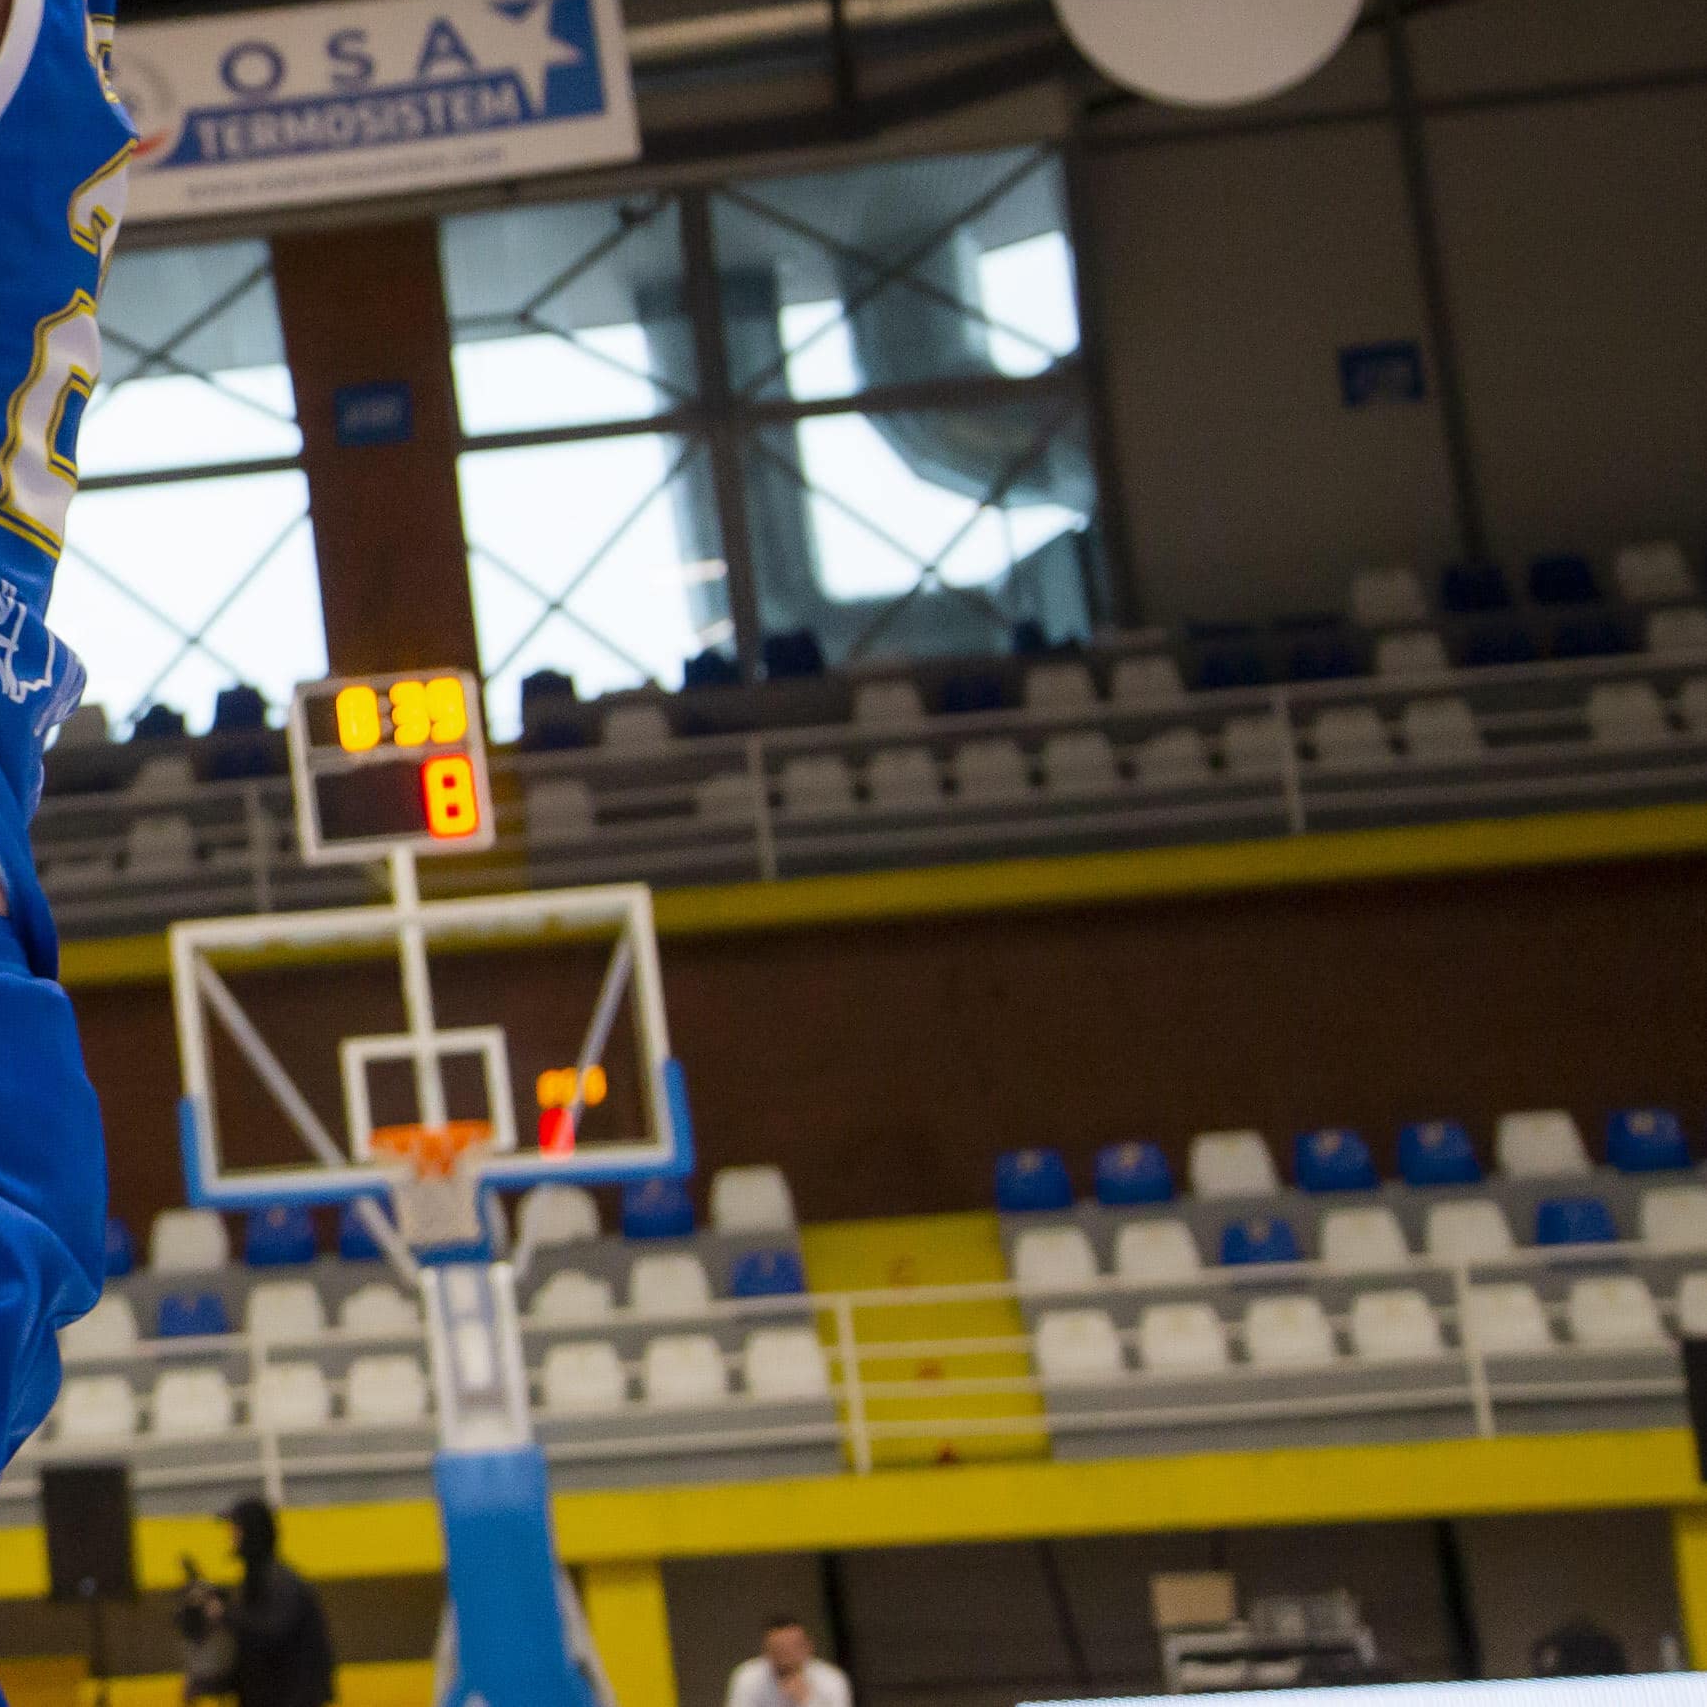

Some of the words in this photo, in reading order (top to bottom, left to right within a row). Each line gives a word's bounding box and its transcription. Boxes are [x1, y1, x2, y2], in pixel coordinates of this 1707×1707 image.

[219, 13, 481, 95] OSA
[195, 80, 522, 161] TERMOSISTEM
[421, 752, 482, 840] 8
